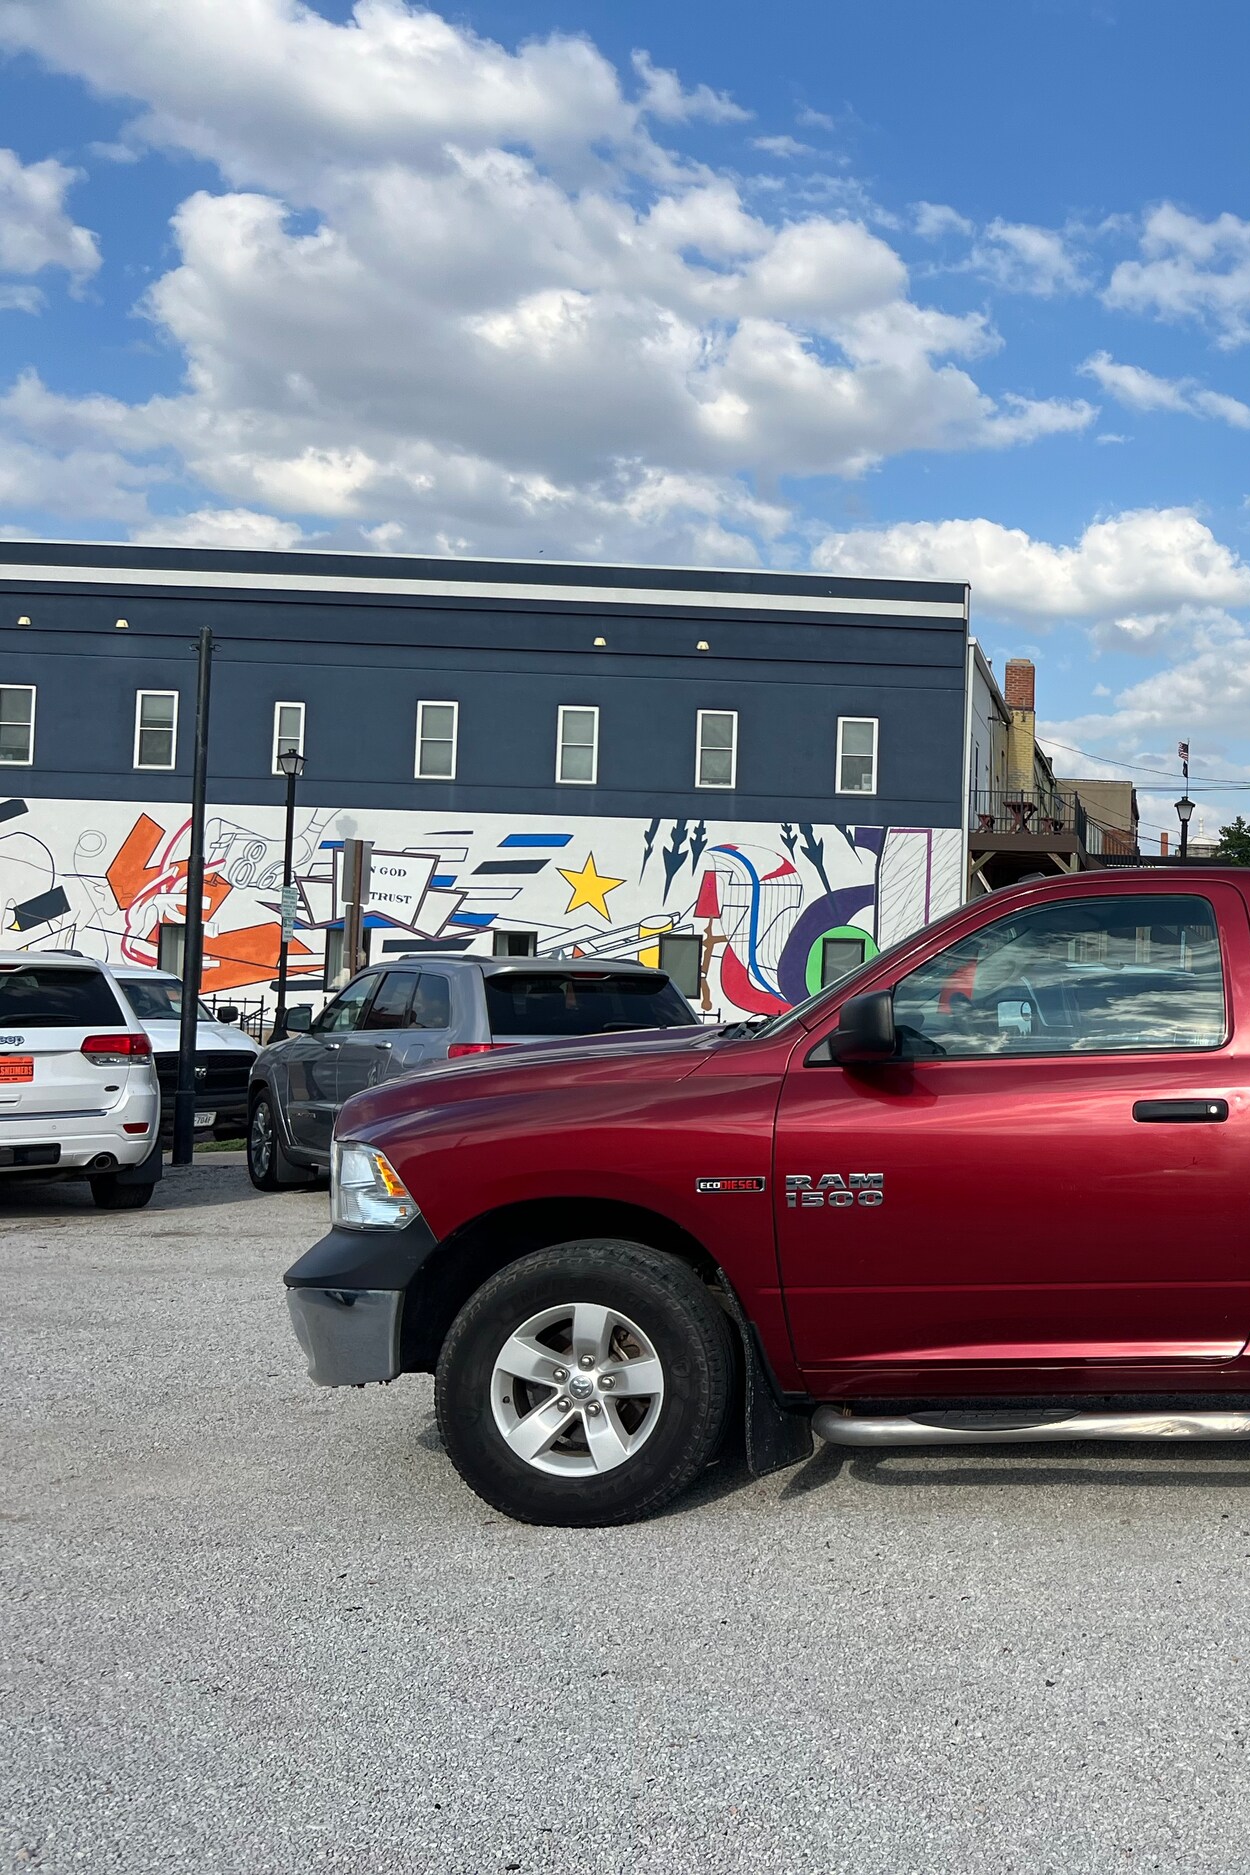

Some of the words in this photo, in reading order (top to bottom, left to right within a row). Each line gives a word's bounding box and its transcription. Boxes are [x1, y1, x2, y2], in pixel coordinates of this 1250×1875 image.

[380, 866, 407, 877] GOD
[369, 891, 412, 904] TRUST
[0, 1035, 25, 1046] eep
[700, 1180, 760, 1190] ECODIESEL
[785, 1173, 884, 1190] RAM
[785, 1190, 884, 1207] 1500
